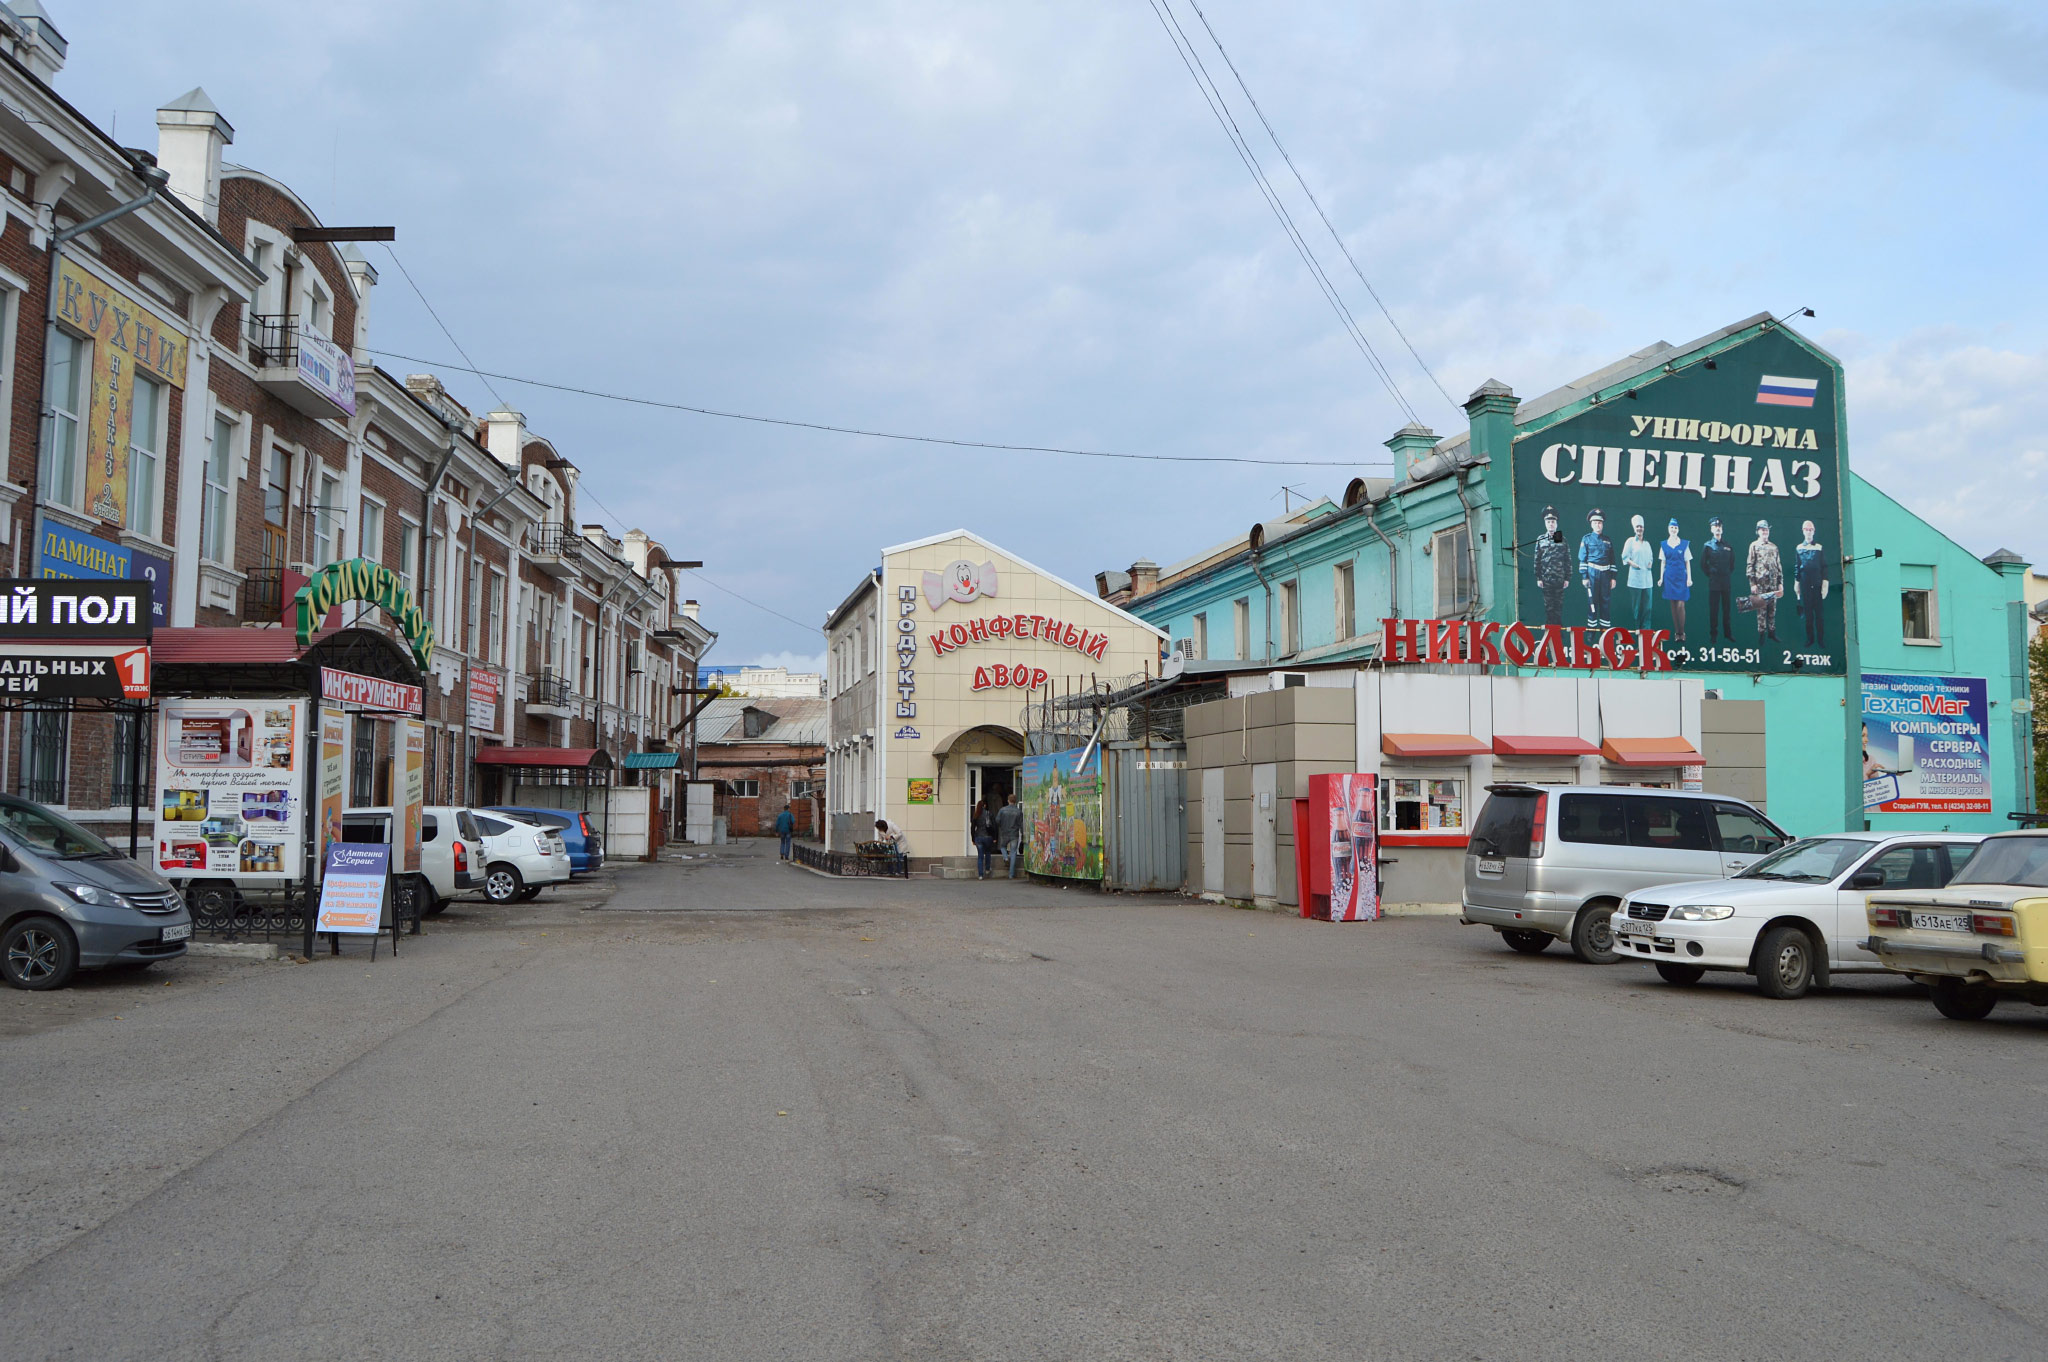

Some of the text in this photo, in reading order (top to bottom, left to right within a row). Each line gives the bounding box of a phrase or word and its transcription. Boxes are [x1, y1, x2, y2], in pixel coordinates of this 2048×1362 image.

[61, 274, 176, 379] КУХНИ
[109, 353, 121, 391] НА
[106, 393, 118, 478] ЗАКАЗ
[1631, 415, 1819, 450] УНИФОРМА
[1540, 443, 1822, 499] СПЕЦНАЗ
[103, 483, 112, 506] 2
[93, 502, 119, 522] этаж
[43, 532, 127, 579] ЛАМИНАТ
[0, 586, 38, 624] Й
[52, 595, 136, 624] ПОЛ
[302, 559, 435, 671] ДОМОСТРОЙ
[928, 614, 1110, 662] КОНФЕТНЫЙ
[1381, 618, 1673, 671] НИКОЛЬСК
[897, 585, 917, 718] ПРОДУКТЫ
[1699, 647, 1761, 664] 31-56-51
[1782, 651, 1792, 664] 2
[0, 660, 106, 675] АЛЬНЫХ
[124, 653, 146, 684] 1
[971, 663, 1049, 692] ДВОР
[124, 684, 149, 692] этаж
[323, 670, 419, 709] ИНСТРУМЕНТ 2
[1891, 683, 1934, 693] цифровой
[1936, 685, 1970, 694] техники
[1861, 692, 1970, 715] ТехноМаг
[1890, 721, 1981, 735] КОМПЬЮТЕРЫ
[1930, 741, 1982, 754] СЕРВЕРА
[1921, 758, 1982, 769] РАСХОДНЫЕ
[190, 769, 230, 778] поможем
[232, 772, 266, 780] создать
[230, 778, 257, 786] Вашей
[1920, 773, 1982, 784] МАТЕРИАЛЫ
[1958, 787, 1983, 795] ДРУГОЕ
[1893, 802, 1915, 810] Старый
[346, 849, 383, 858] Антенна
[346, 857, 375, 866] Сервис
[1913, 914, 1969, 929] К513АЕ 125
